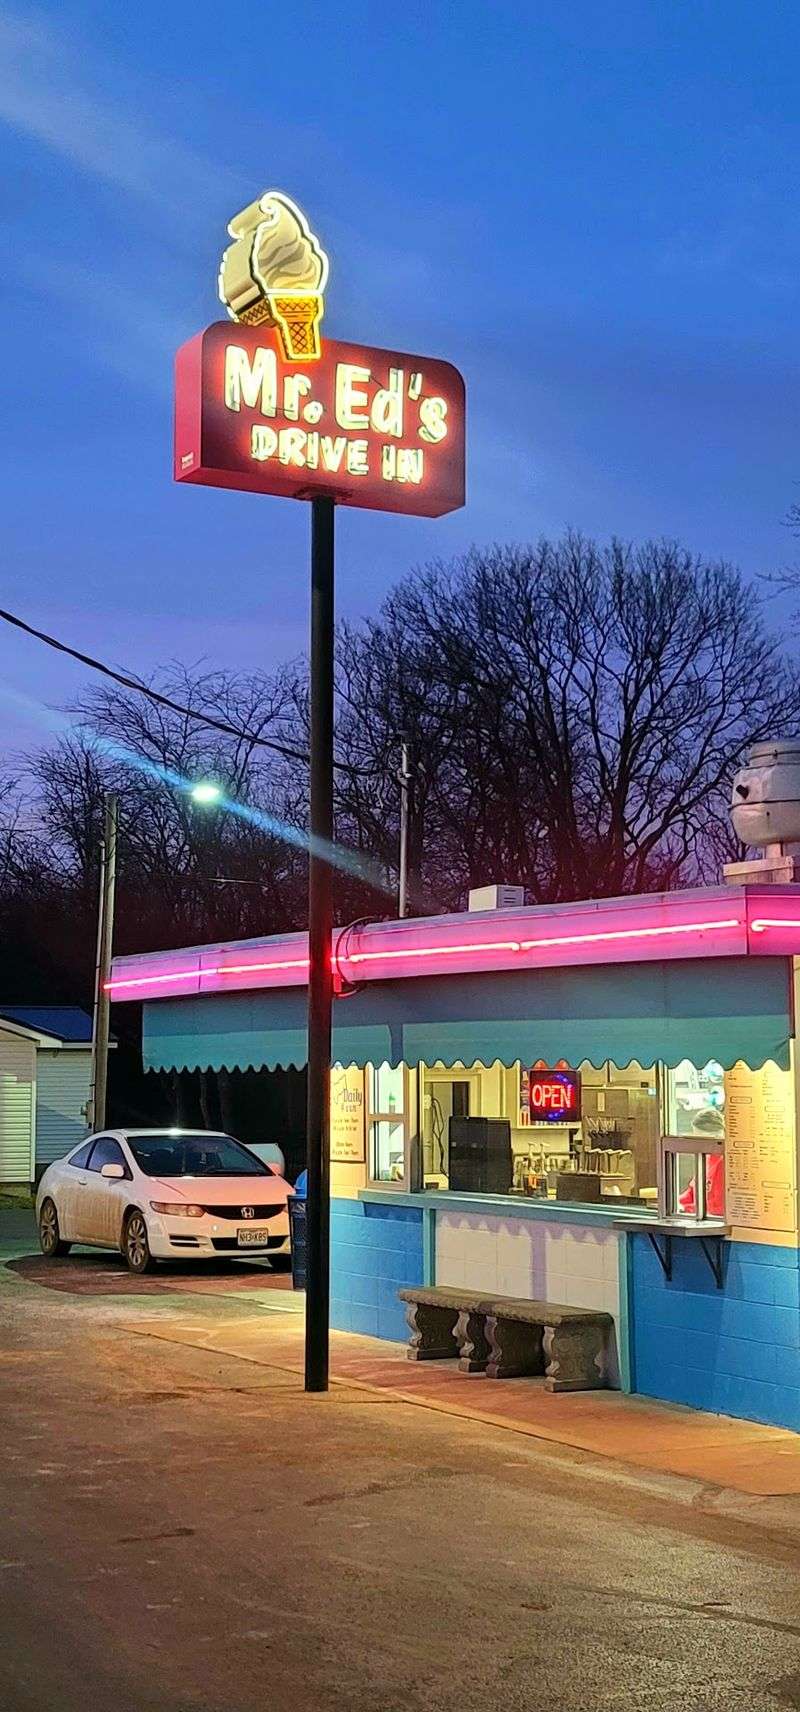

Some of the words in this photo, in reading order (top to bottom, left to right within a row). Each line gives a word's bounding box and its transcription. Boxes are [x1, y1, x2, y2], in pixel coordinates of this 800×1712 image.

[225, 344, 324, 424] Mr.
[335, 362, 448, 444] Ed's
[251, 424, 368, 476] DRIVE
[382, 444, 424, 484] IN
[532, 1084, 572, 1108] OPEN
